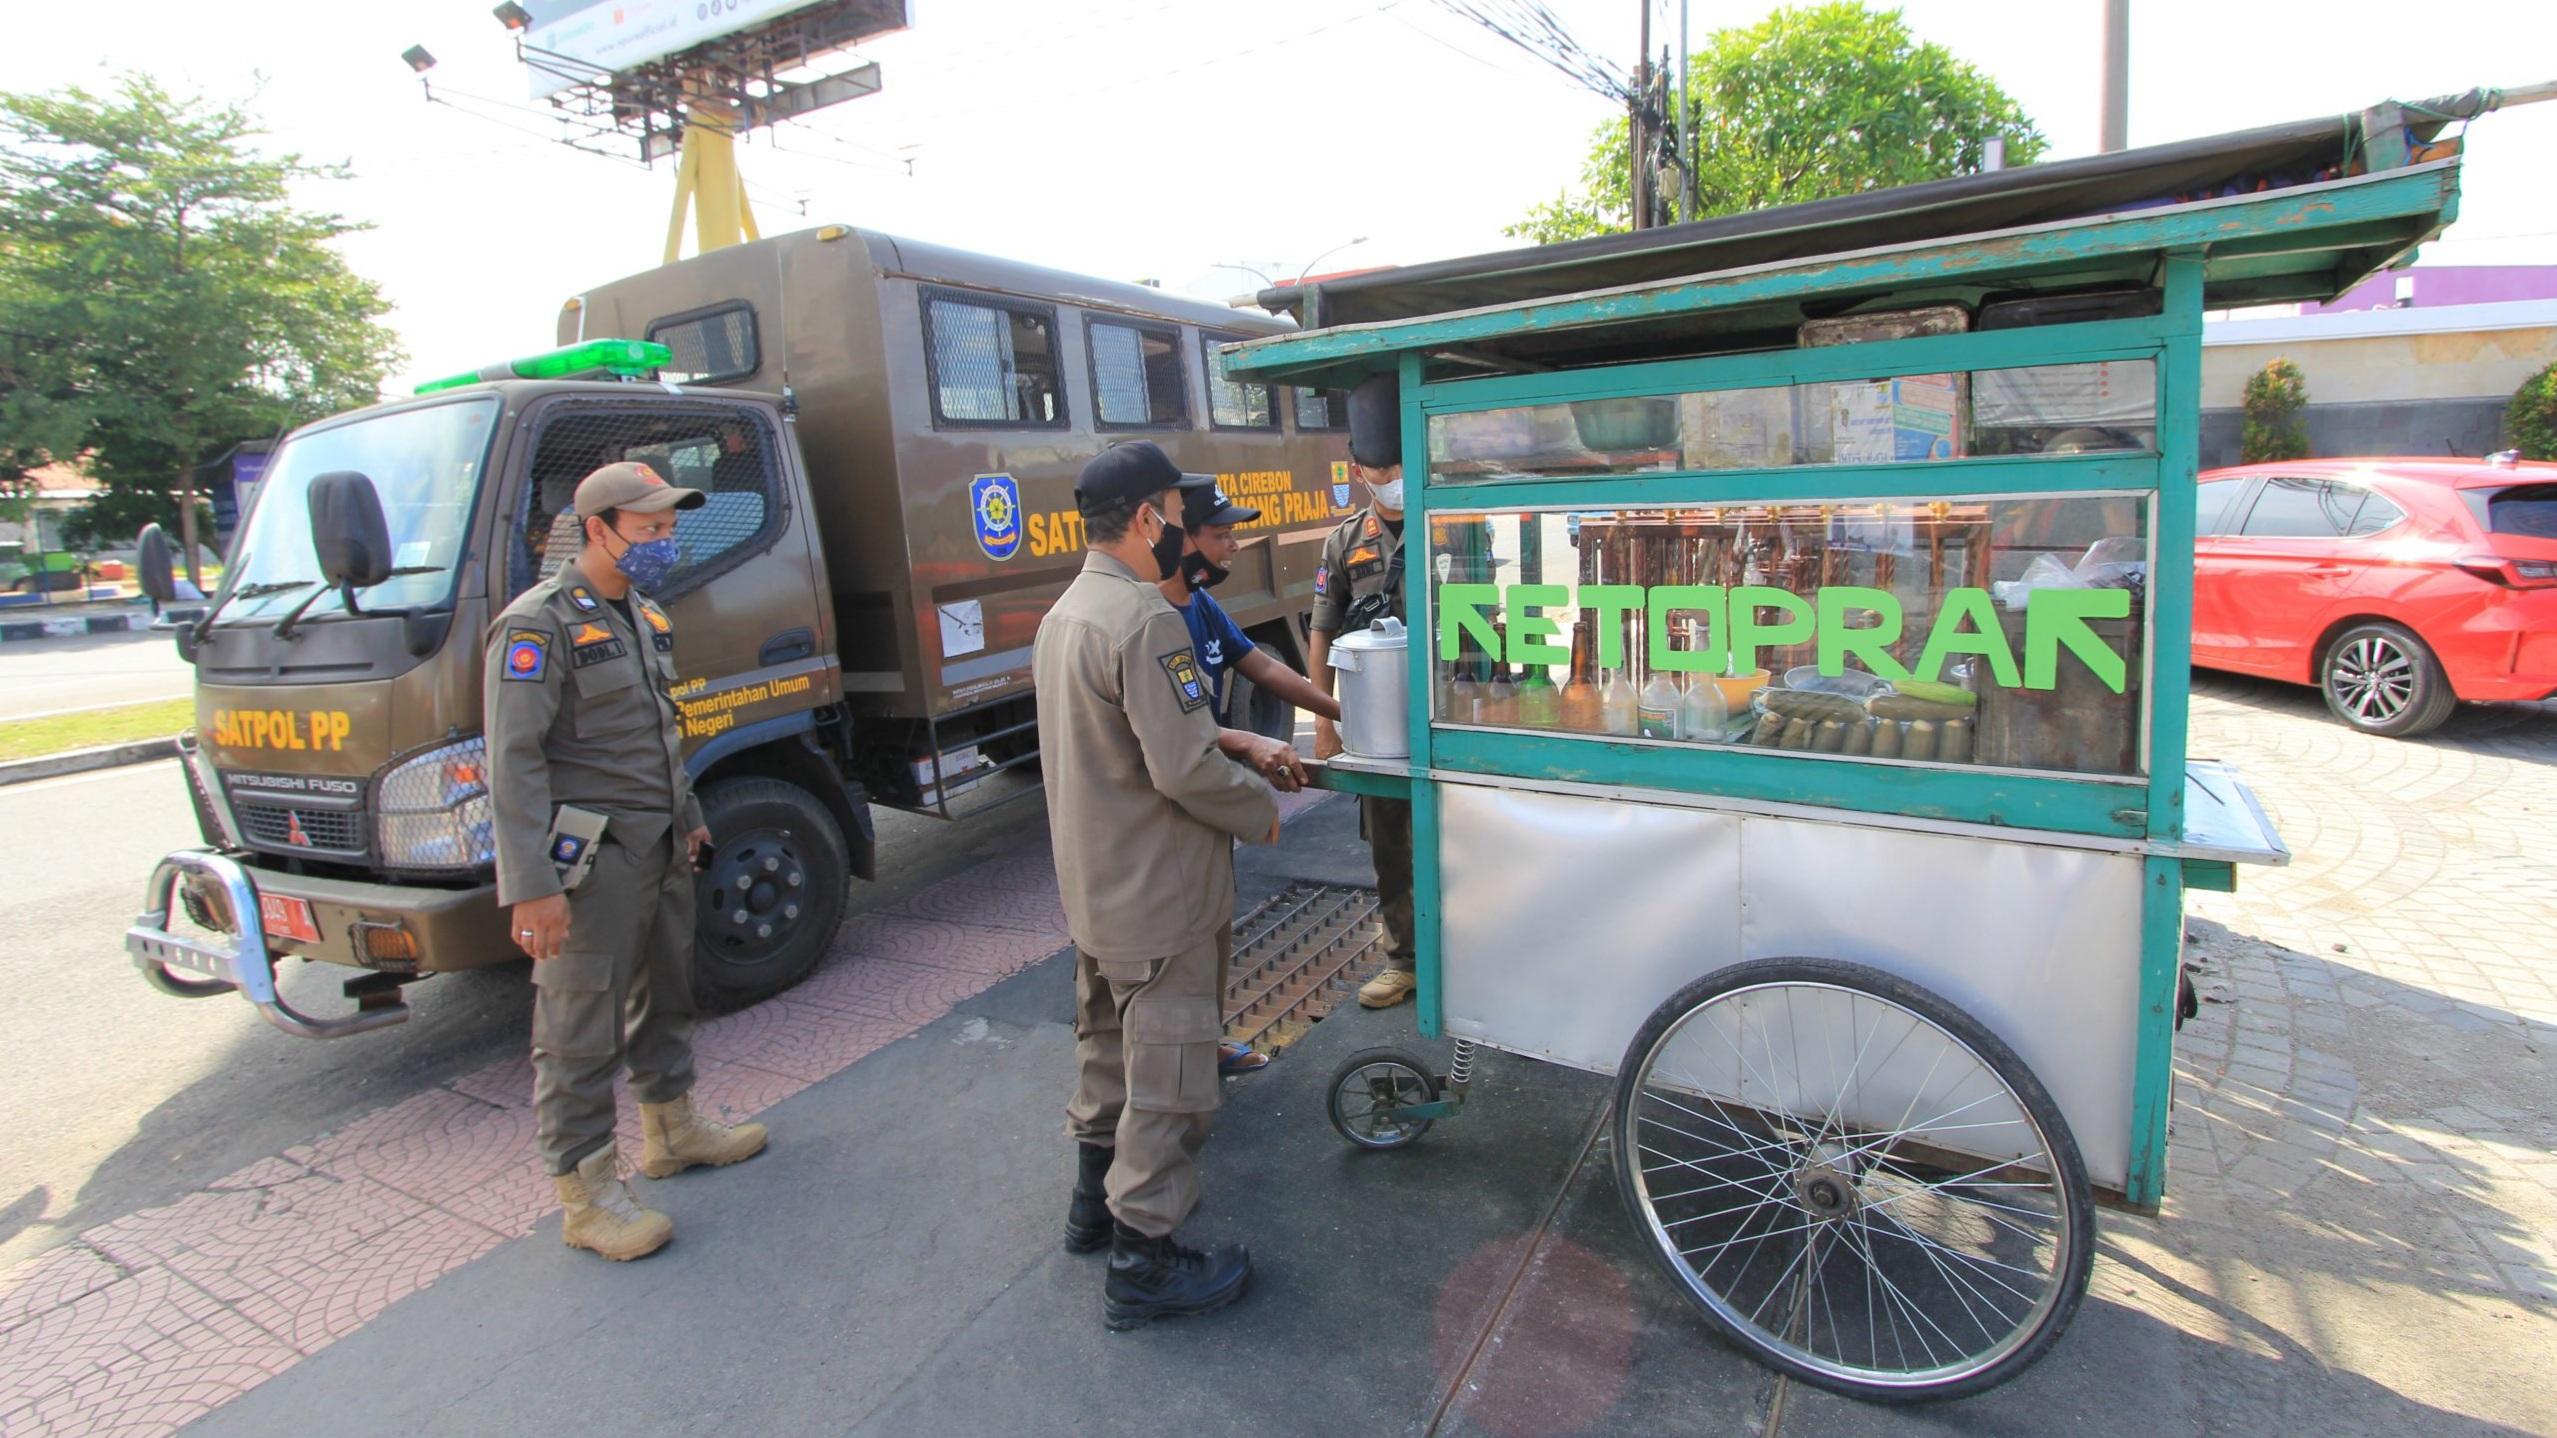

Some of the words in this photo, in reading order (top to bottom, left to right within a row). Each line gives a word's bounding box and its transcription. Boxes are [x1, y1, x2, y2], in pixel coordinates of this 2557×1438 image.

[1240, 471, 1292, 495] CIREBON
[1283, 489, 1329, 524] PRAJA
[1028, 510, 1087, 557] SAT
[1439, 583, 2131, 694] KETOPRAK
[690, 677, 707, 692] PP
[769, 675, 810, 697] Umum
[214, 709, 306, 750] SATPOL
[309, 710, 350, 752] PP
[686, 708, 734, 737] Negeri
[226, 773, 306, 790] MITSUBISHI
[307, 779, 357, 793] FUSO
